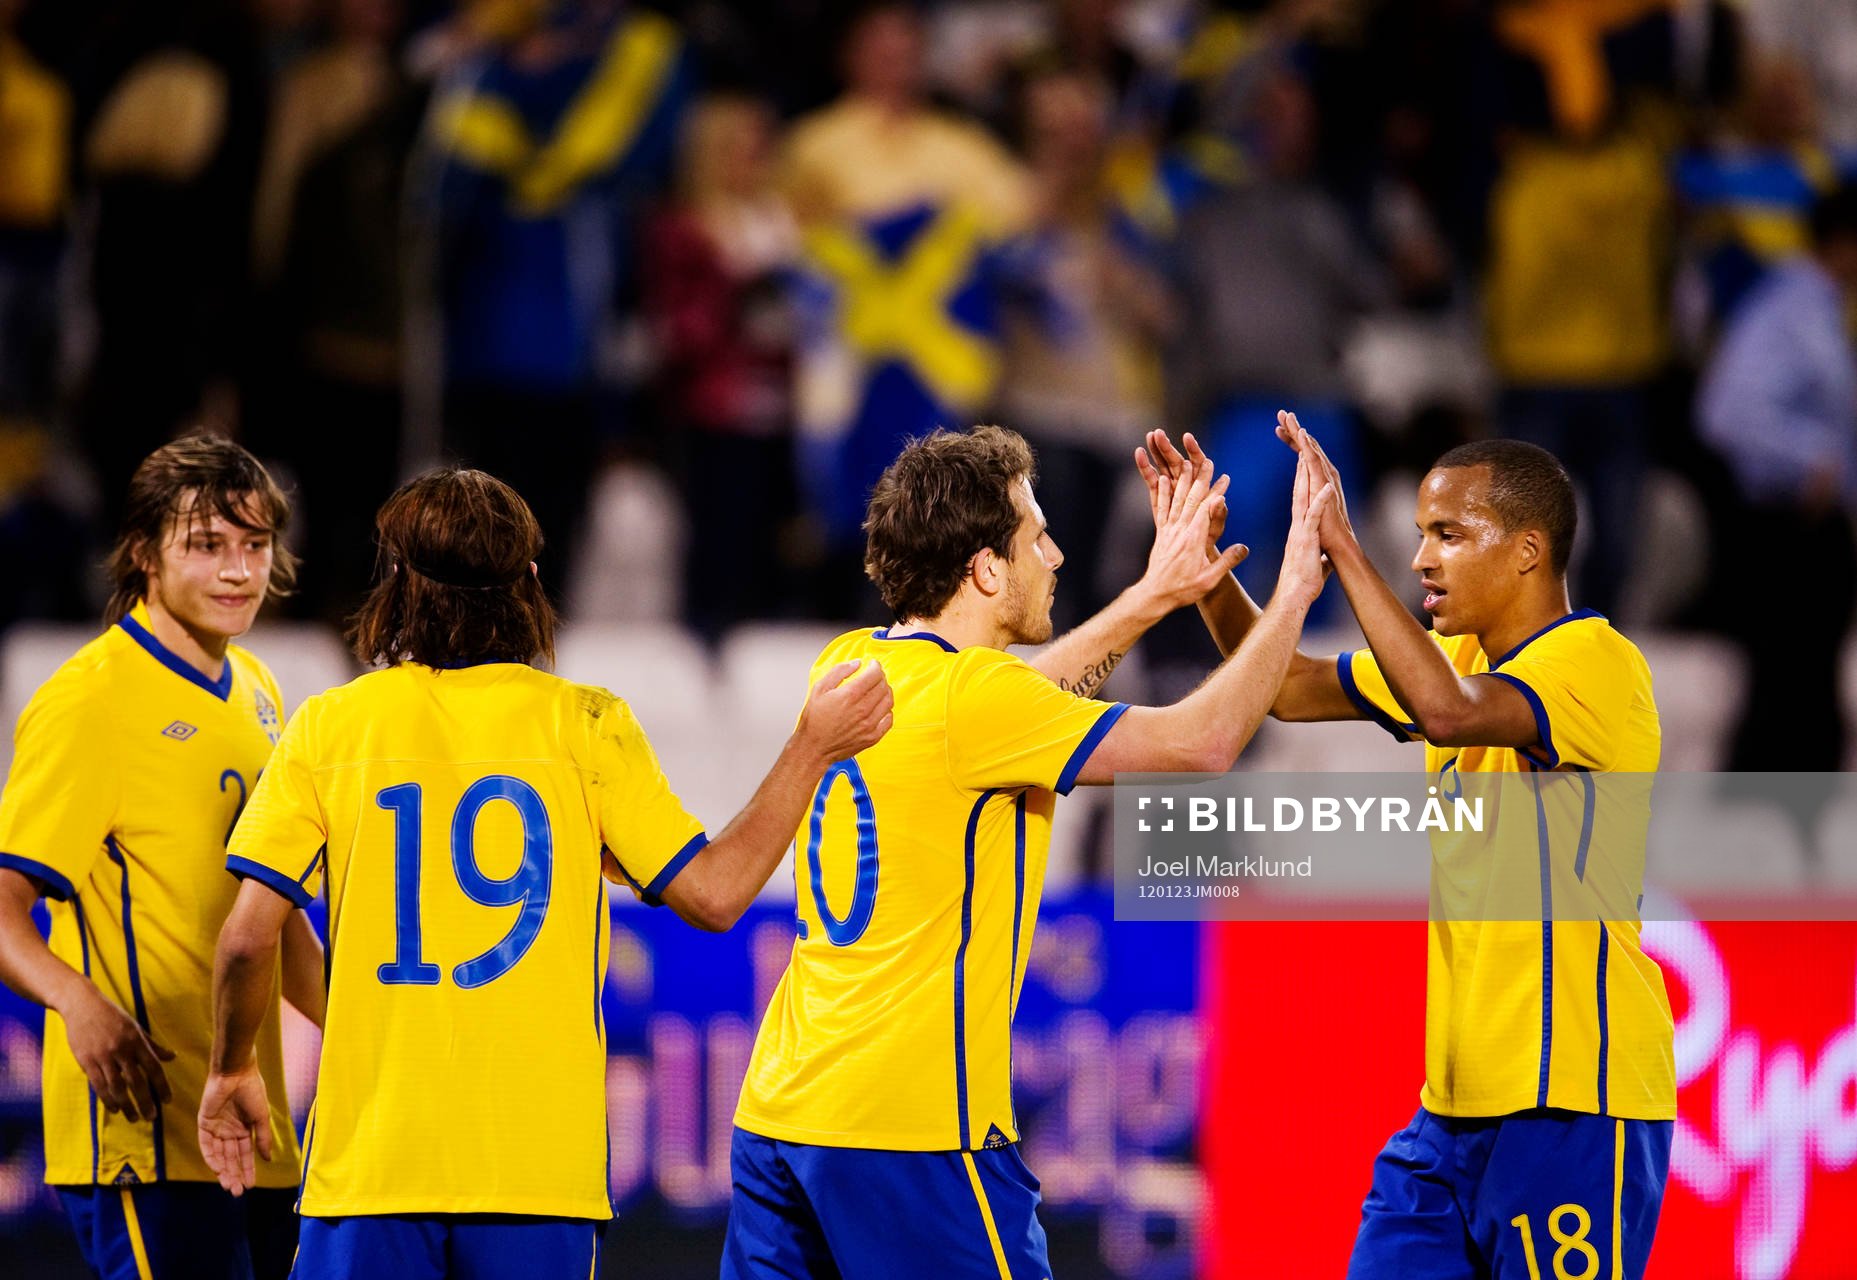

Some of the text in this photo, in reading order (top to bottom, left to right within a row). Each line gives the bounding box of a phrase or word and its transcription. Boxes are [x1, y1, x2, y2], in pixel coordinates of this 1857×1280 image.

[375, 774, 553, 989] 19
[794, 757, 879, 947] 0
[1511, 1203, 1600, 1280] 18
